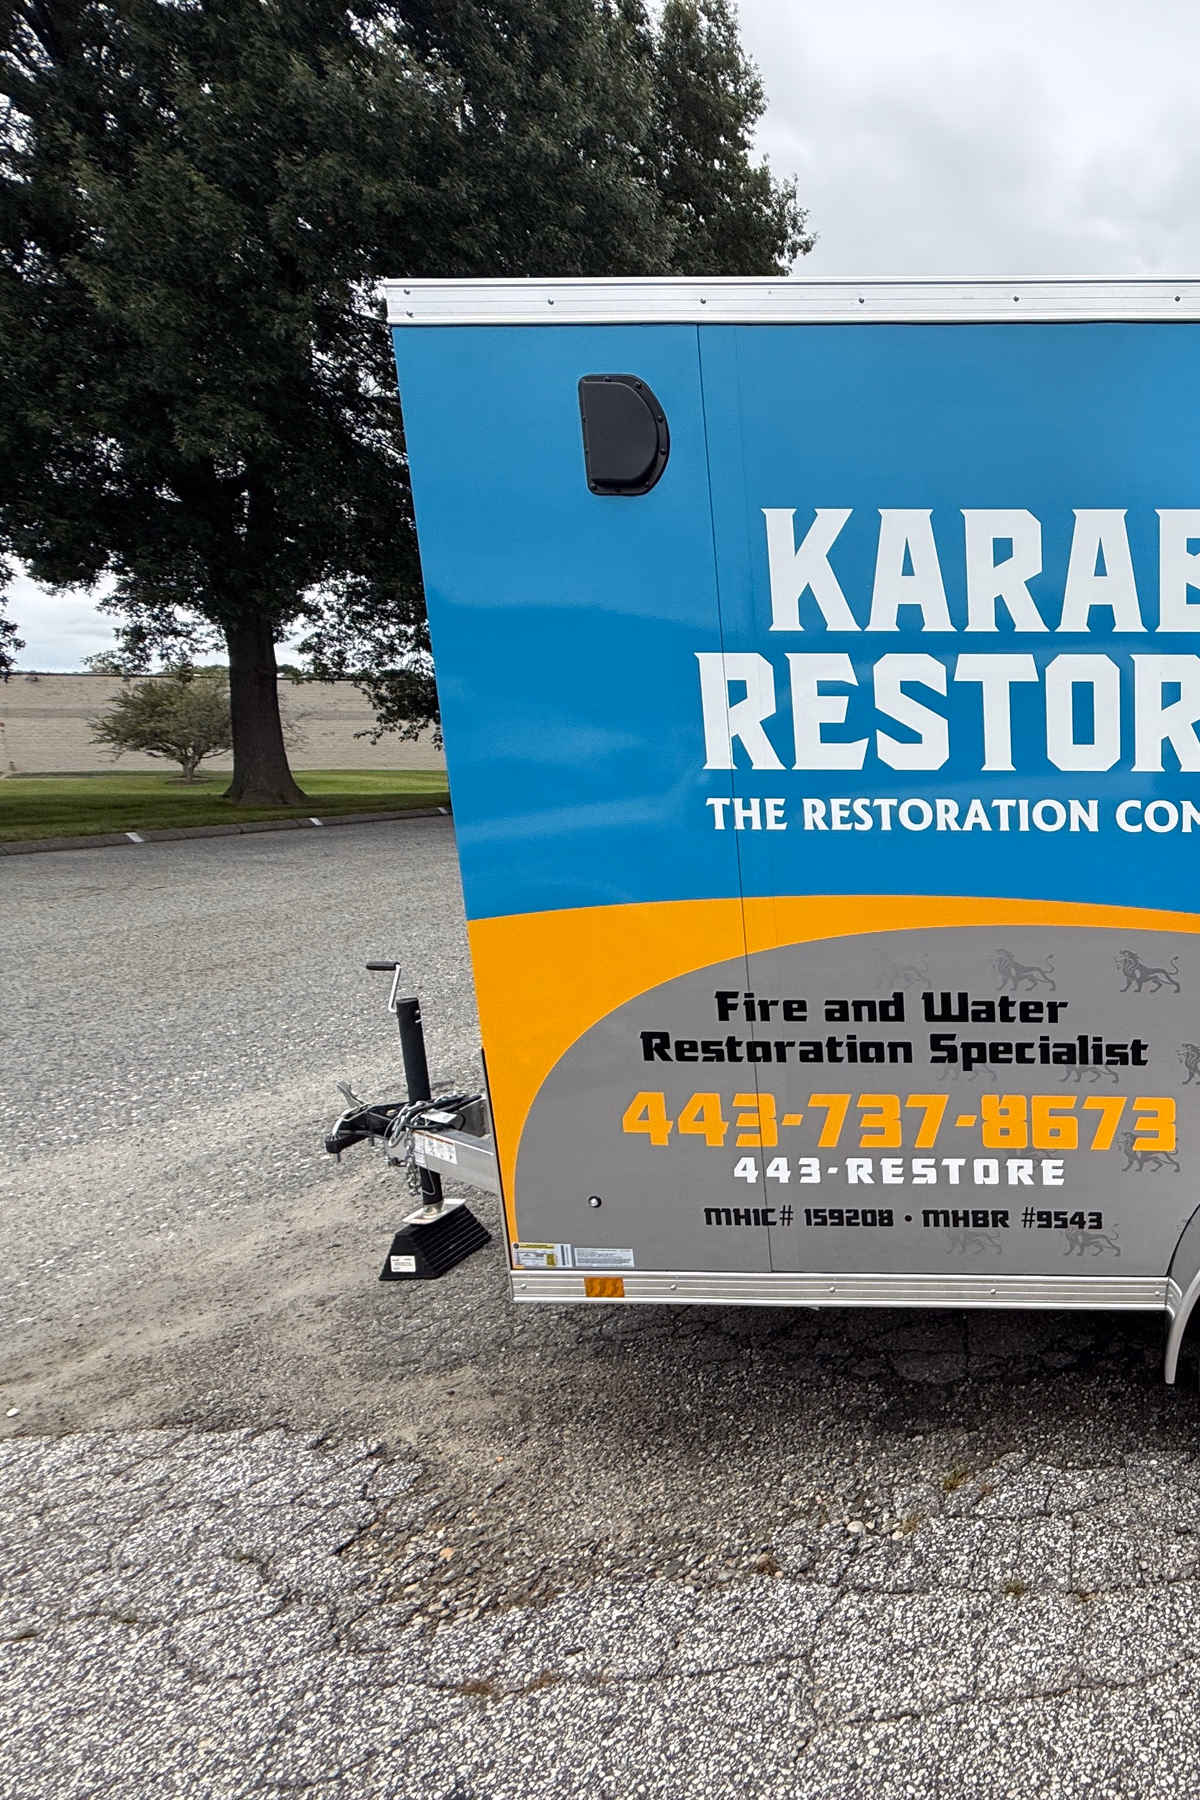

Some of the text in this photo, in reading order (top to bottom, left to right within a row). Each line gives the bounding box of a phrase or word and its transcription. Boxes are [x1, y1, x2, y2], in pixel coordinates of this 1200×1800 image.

[704, 796, 789, 832] THE
[801, 797, 1100, 833] RESTORATION
[713, 989, 1070, 1025] Fire and Water
[638, 1030, 1151, 1073] Restoration Specialist
[621, 1090, 1178, 1153] 443-737-8673
[732, 1155, 1066, 1187] 443-RESTORE
[703, 1203, 1104, 1231] MHIC# 159208 MHBR #9543
